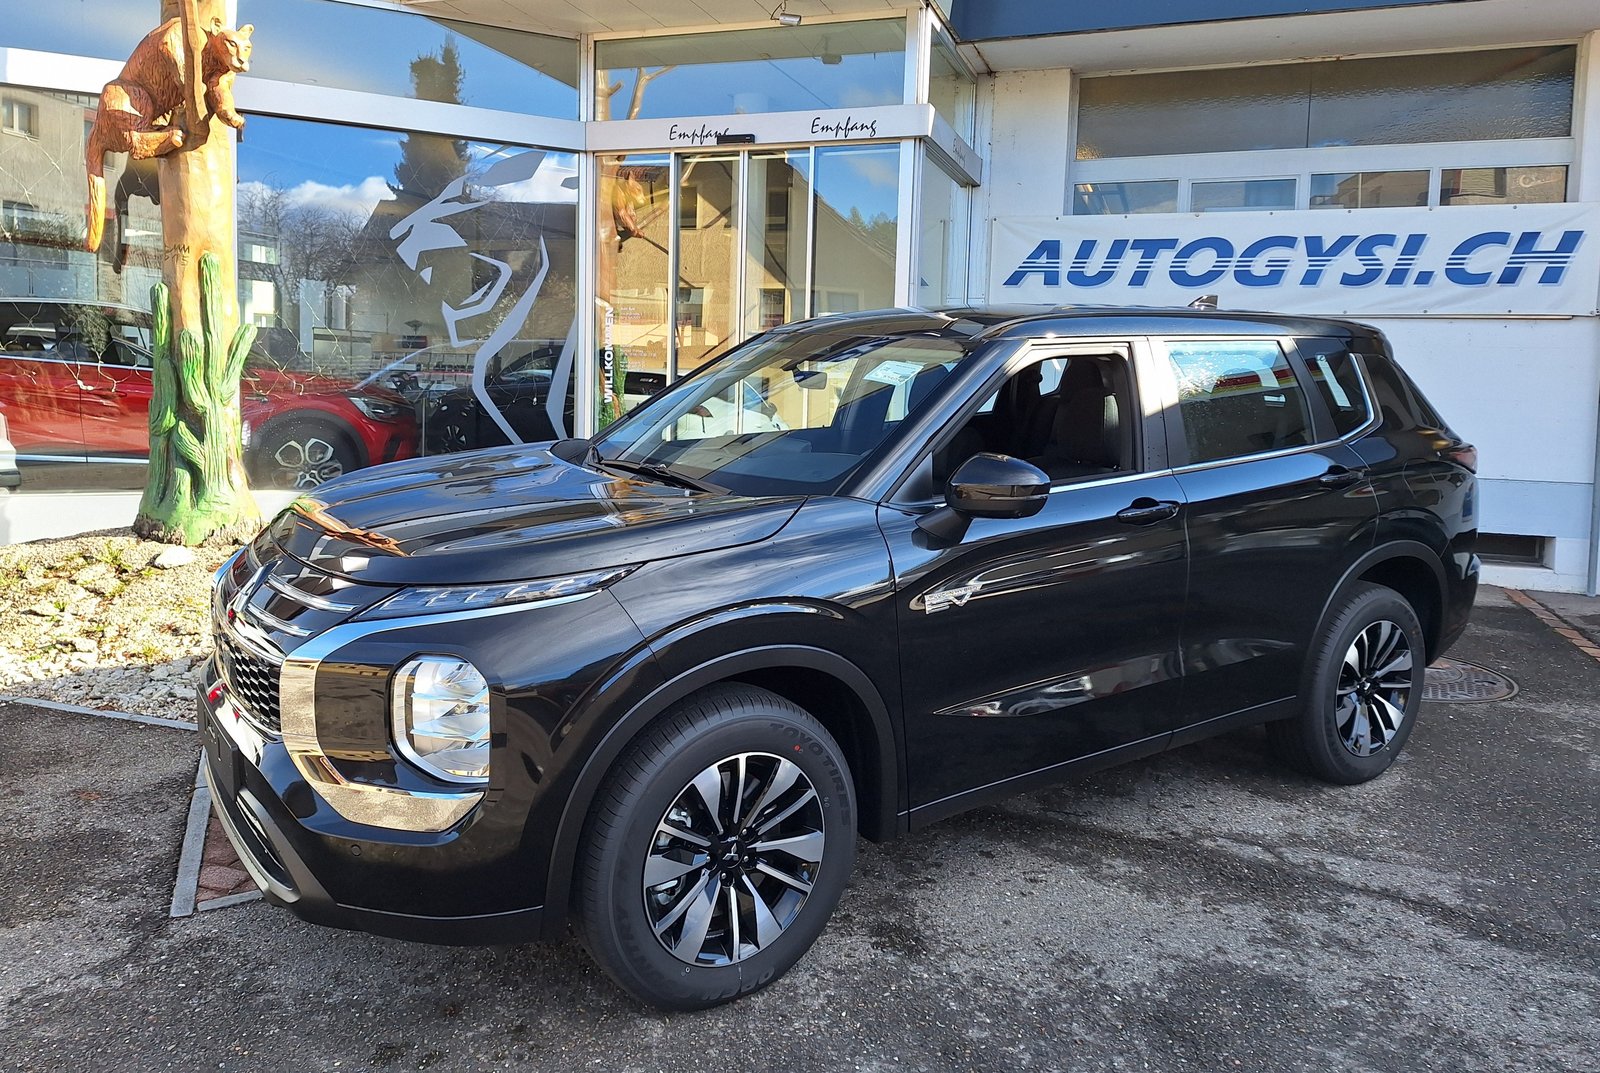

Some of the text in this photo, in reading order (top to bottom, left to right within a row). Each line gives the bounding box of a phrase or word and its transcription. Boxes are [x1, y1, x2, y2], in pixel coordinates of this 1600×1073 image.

[810, 116, 877, 138] Empfang
[1003, 230, 1585, 288] AUTOGYSI.CH
[770, 723, 823, 756] TOYO
